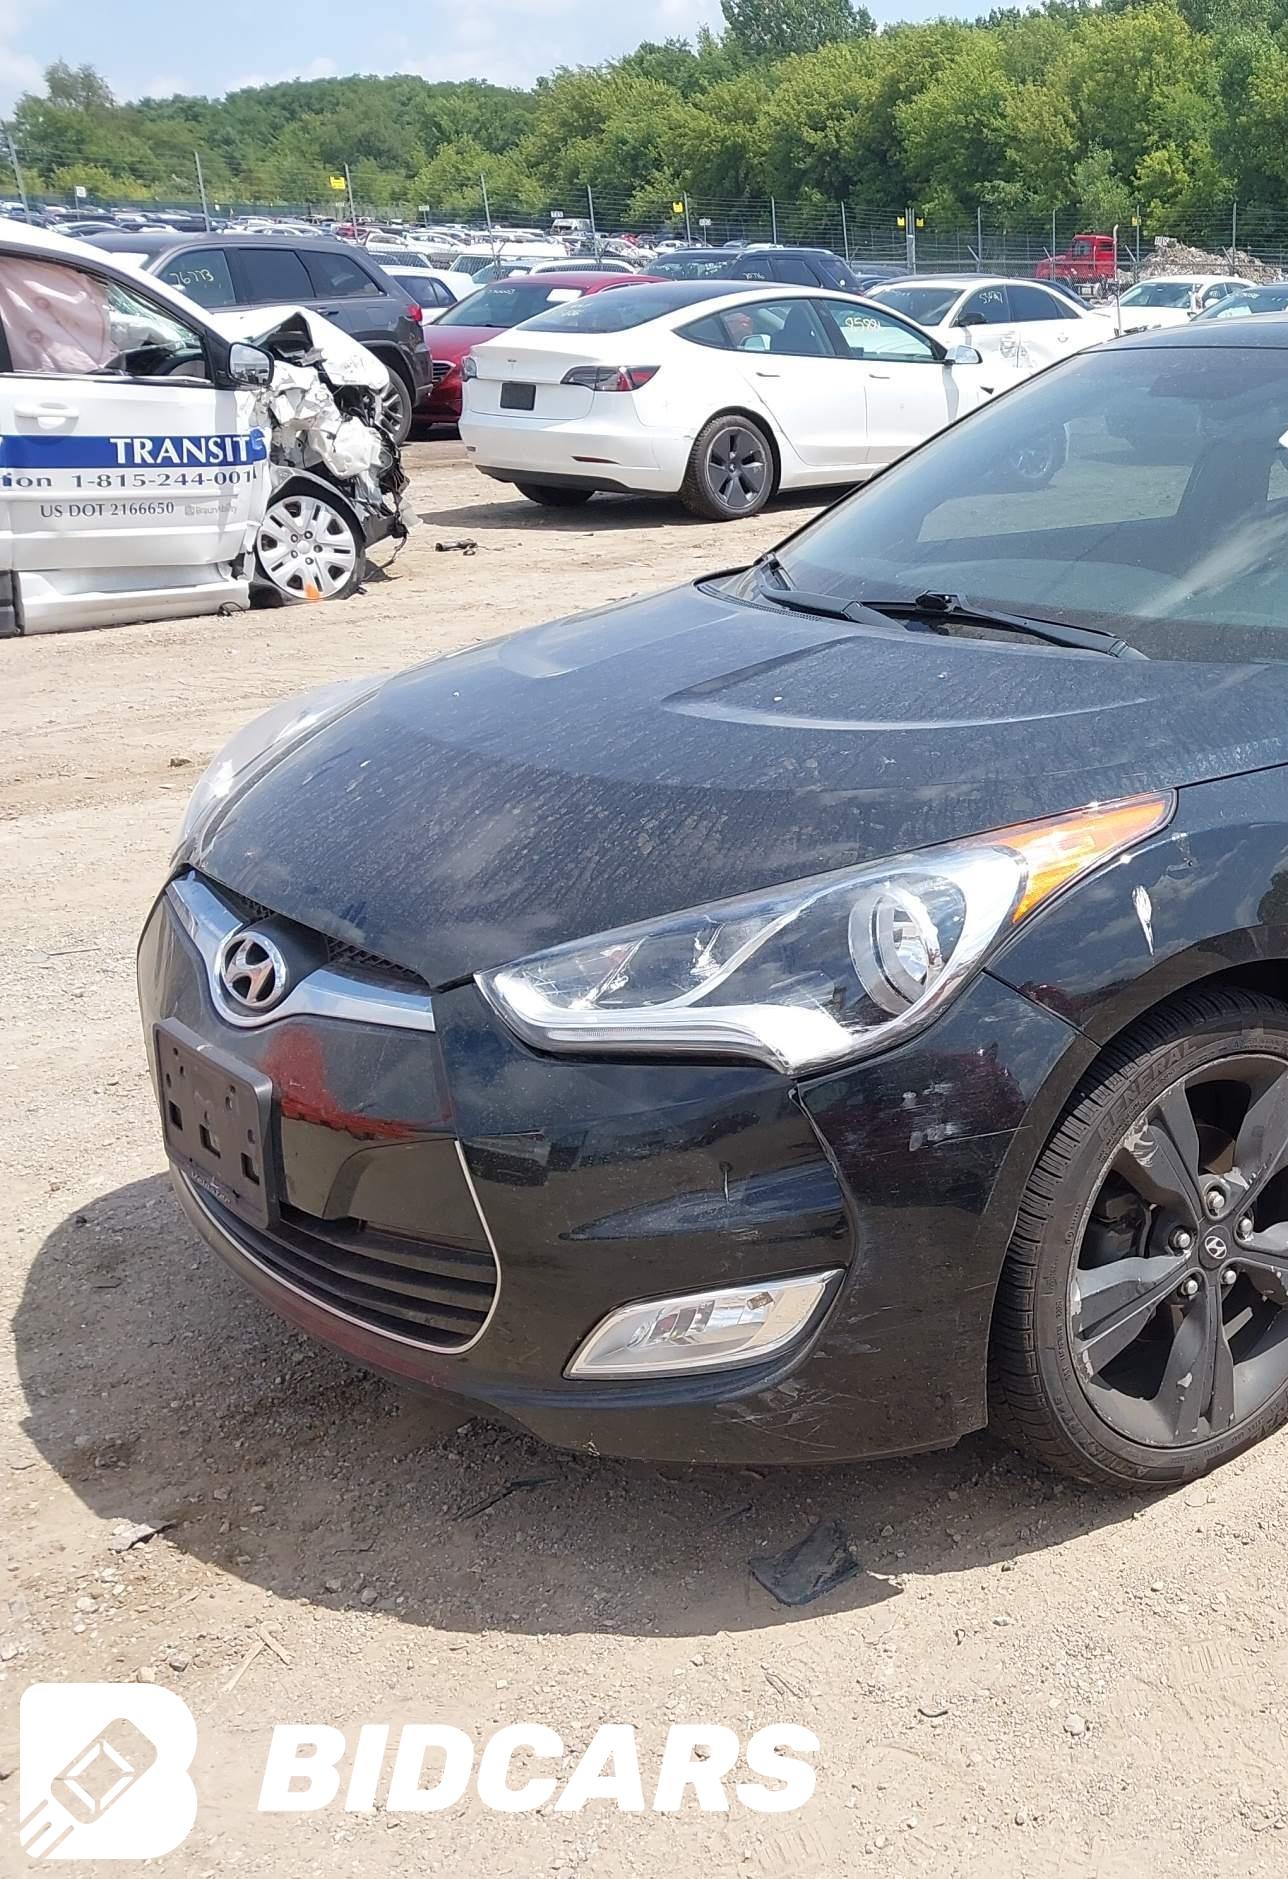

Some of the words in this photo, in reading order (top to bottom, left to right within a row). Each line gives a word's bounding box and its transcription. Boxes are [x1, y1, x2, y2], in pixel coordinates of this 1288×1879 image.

[109, 436, 250, 464] TRANSIT
[40, 504, 63, 518] US
[69, 503, 105, 517] DOT
[110, 501, 175, 516] 2166650
